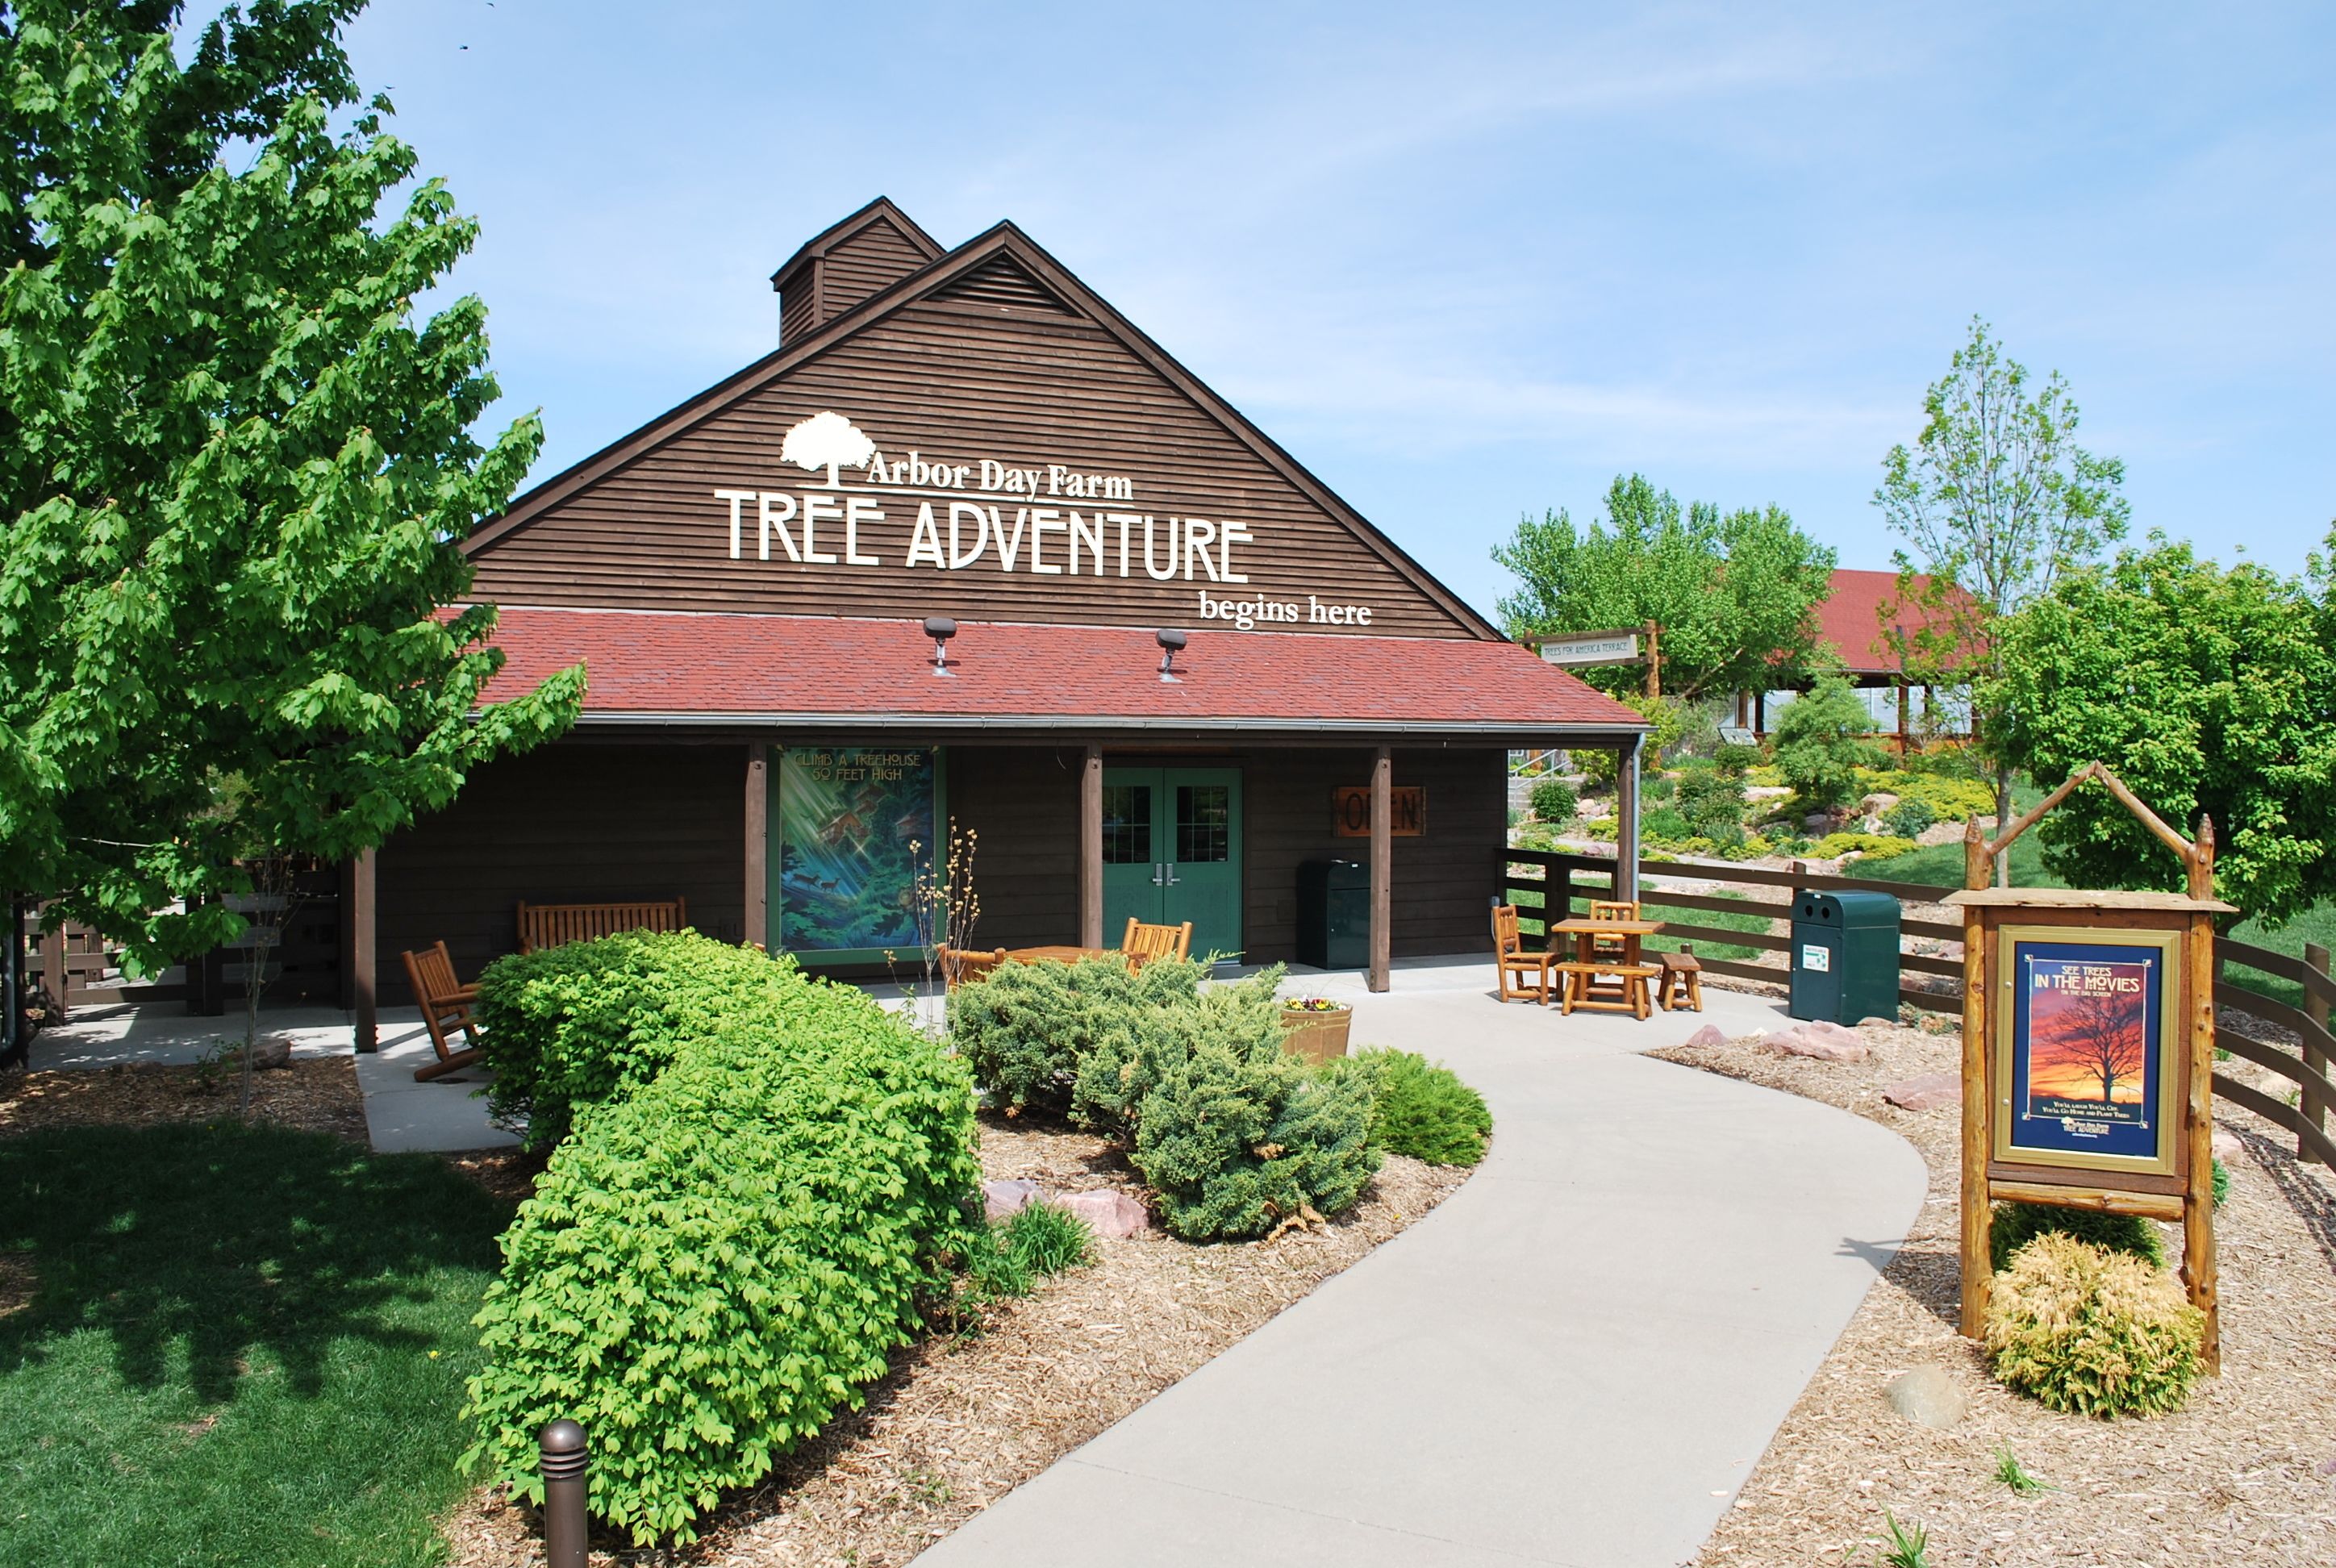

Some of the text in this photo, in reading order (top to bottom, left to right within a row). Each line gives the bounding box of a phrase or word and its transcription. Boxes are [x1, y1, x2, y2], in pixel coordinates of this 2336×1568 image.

[866, 451, 1134, 502] Arbor Day Farm
[714, 489, 1254, 584] TREE ADVENTURE
[1198, 590, 1372, 630] begins here
[1545, 642, 1628, 656] TREES FOR AMERICA TERRACE
[794, 753, 921, 766] CLIMB A TREEHOUSE
[812, 767, 902, 781] 50 FEET HIGH
[1345, 793, 1416, 831] ON
[2062, 965, 2112, 977] SEE TREES
[2034, 974, 2140, 993] IN THE MOVIES
